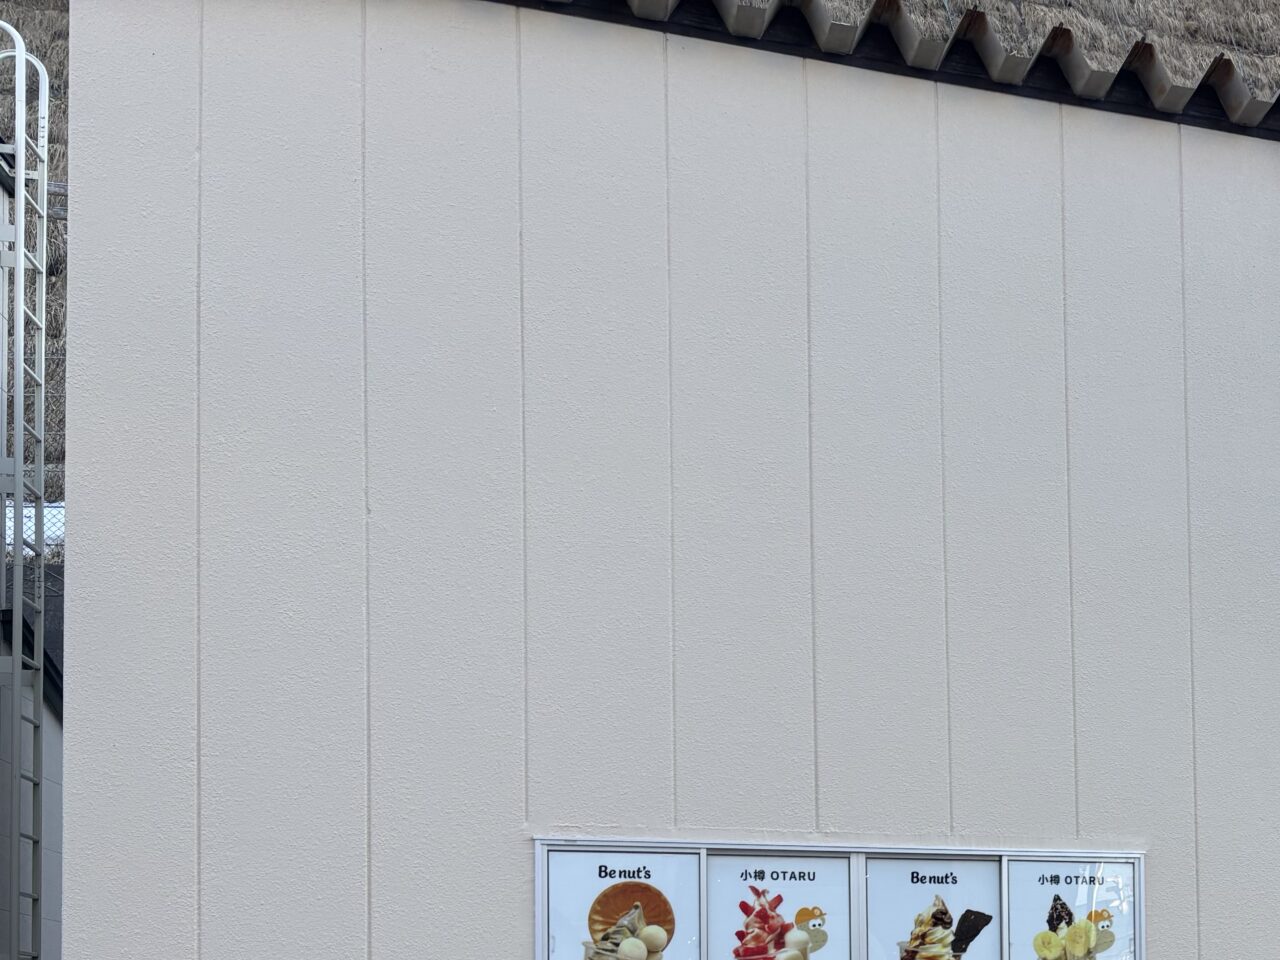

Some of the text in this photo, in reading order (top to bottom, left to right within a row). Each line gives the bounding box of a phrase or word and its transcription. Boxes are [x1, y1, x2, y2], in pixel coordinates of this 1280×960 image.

[740, 869, 816, 882] 小樽 OTARU
[1037, 874, 1105, 886] 小樽 OTARU
